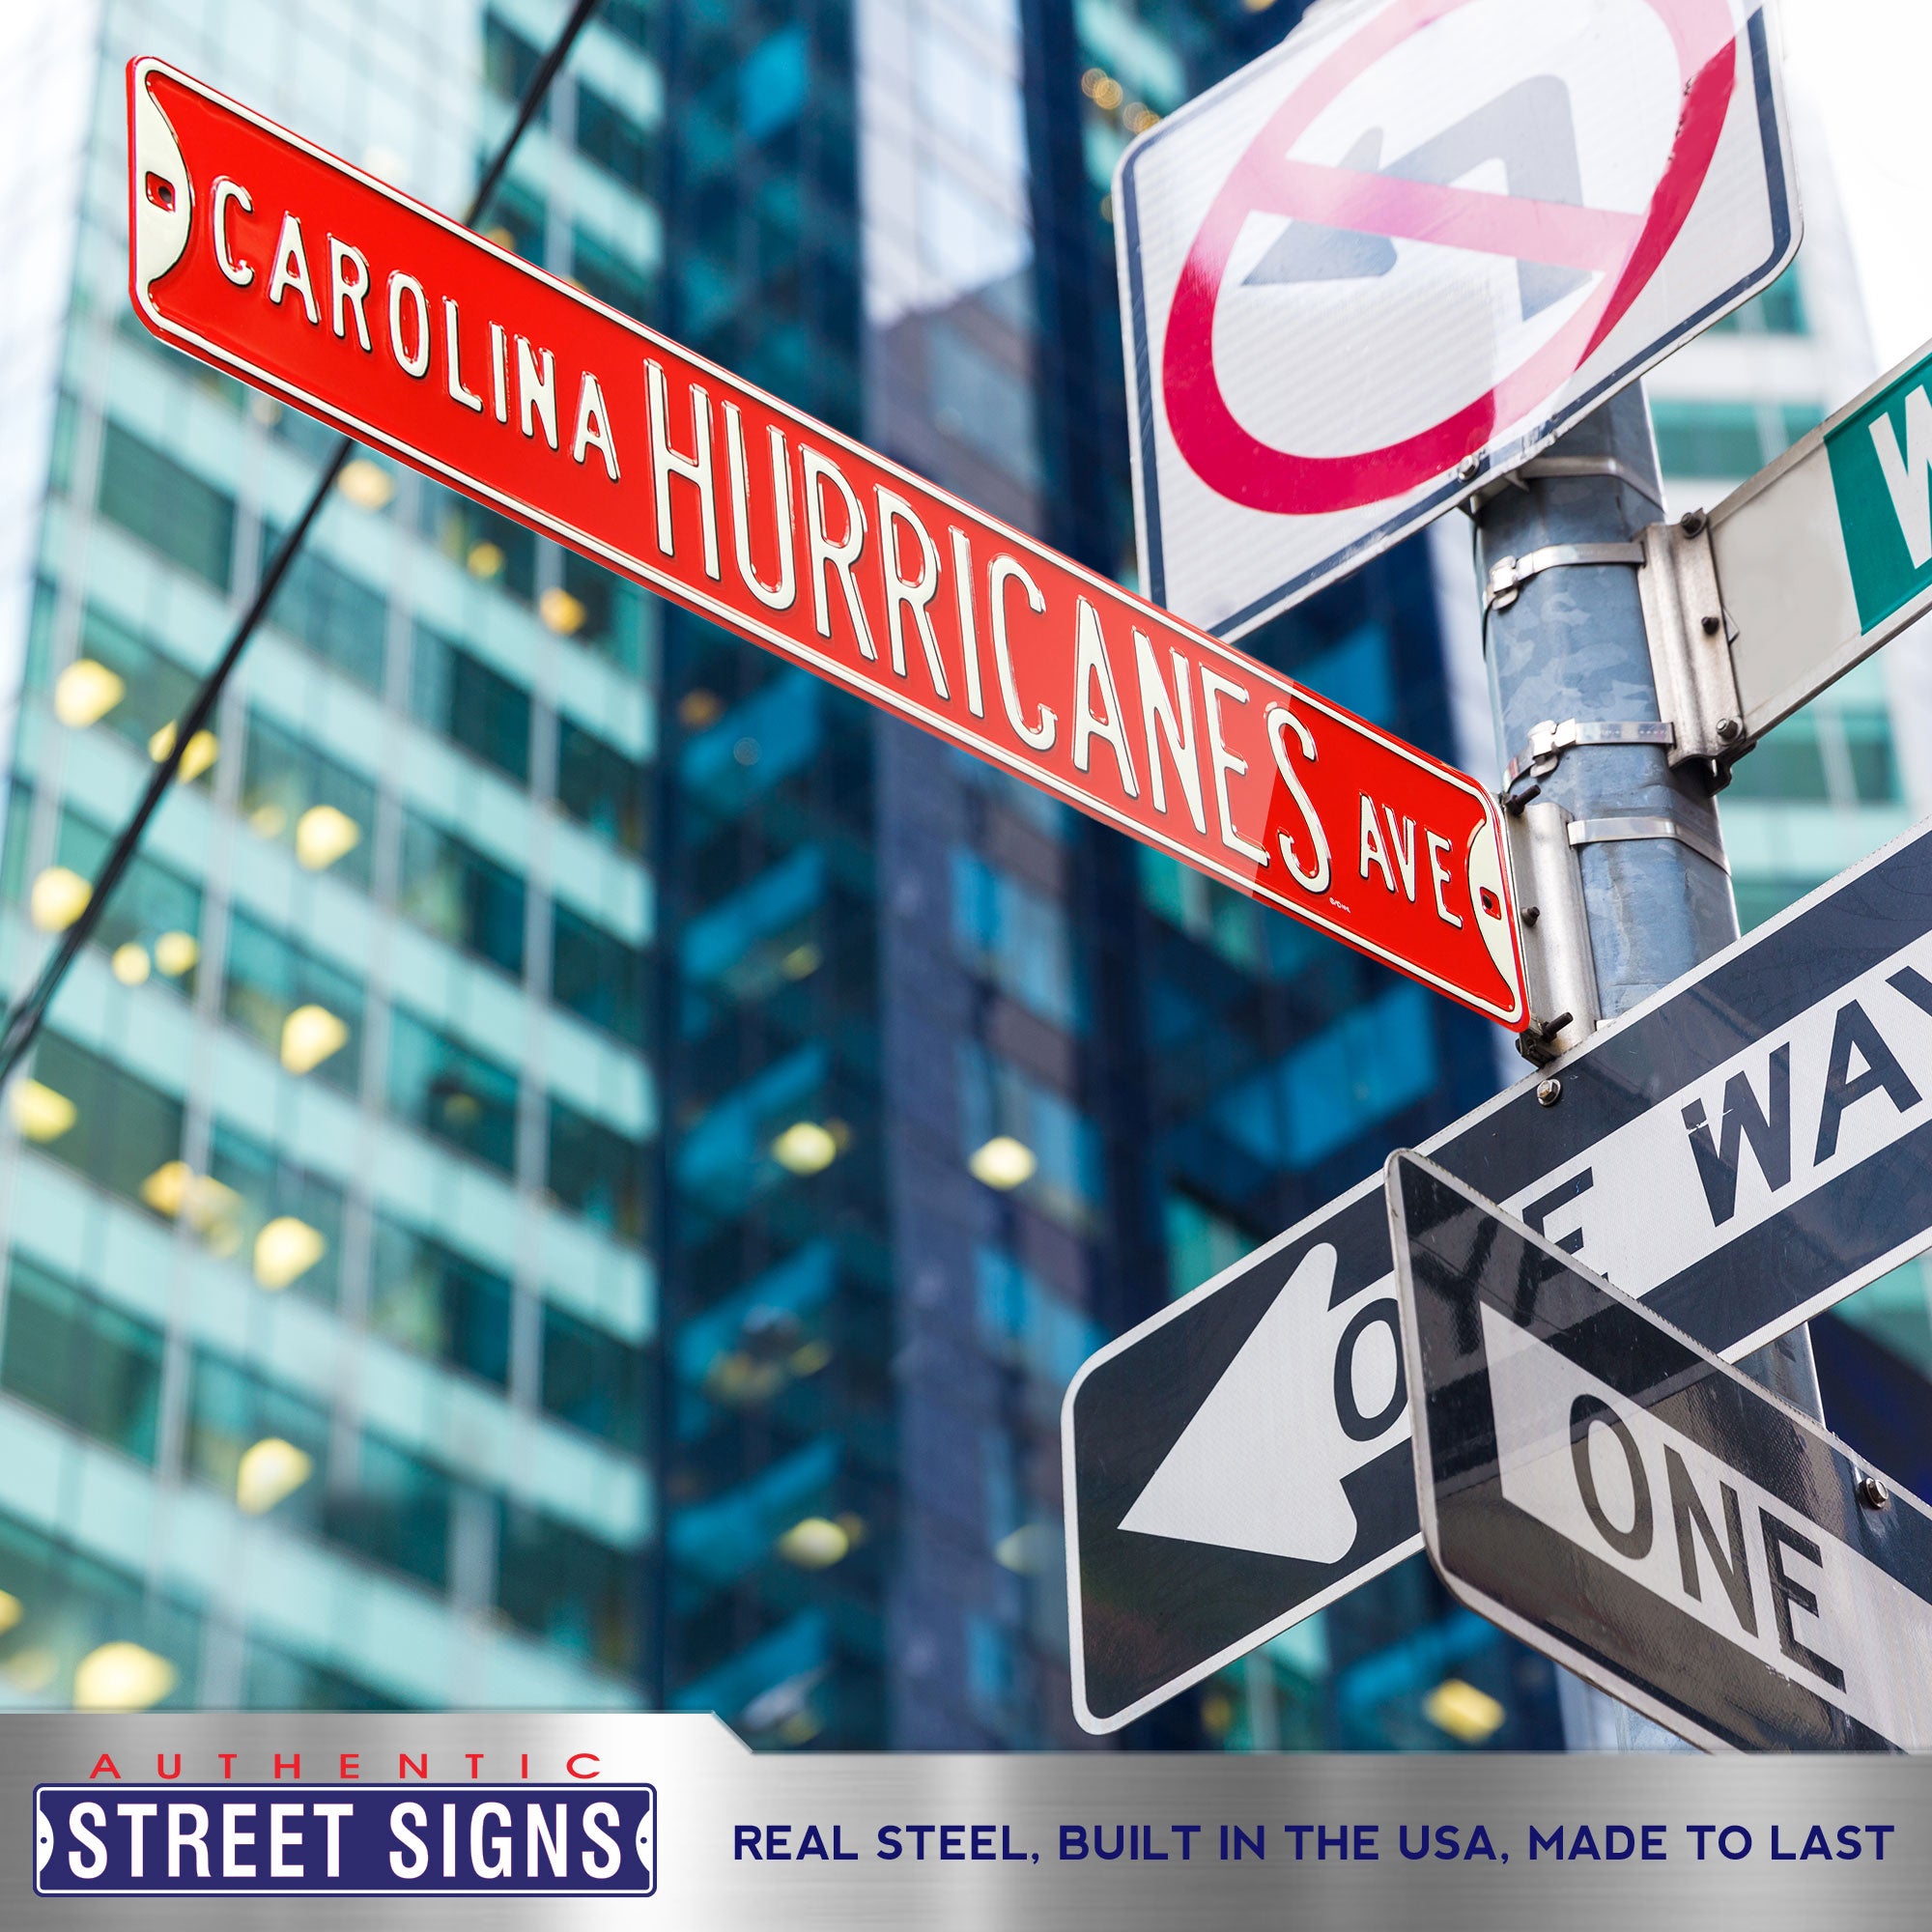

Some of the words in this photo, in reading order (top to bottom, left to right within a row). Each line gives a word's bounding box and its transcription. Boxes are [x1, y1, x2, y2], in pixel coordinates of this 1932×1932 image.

[213, 176, 620, 481] CAROLINA
[643, 358, 1331, 894] HURRICANES
[1358, 790, 1463, 928] AVE
[1569, 1394, 1847, 1694] ONE
